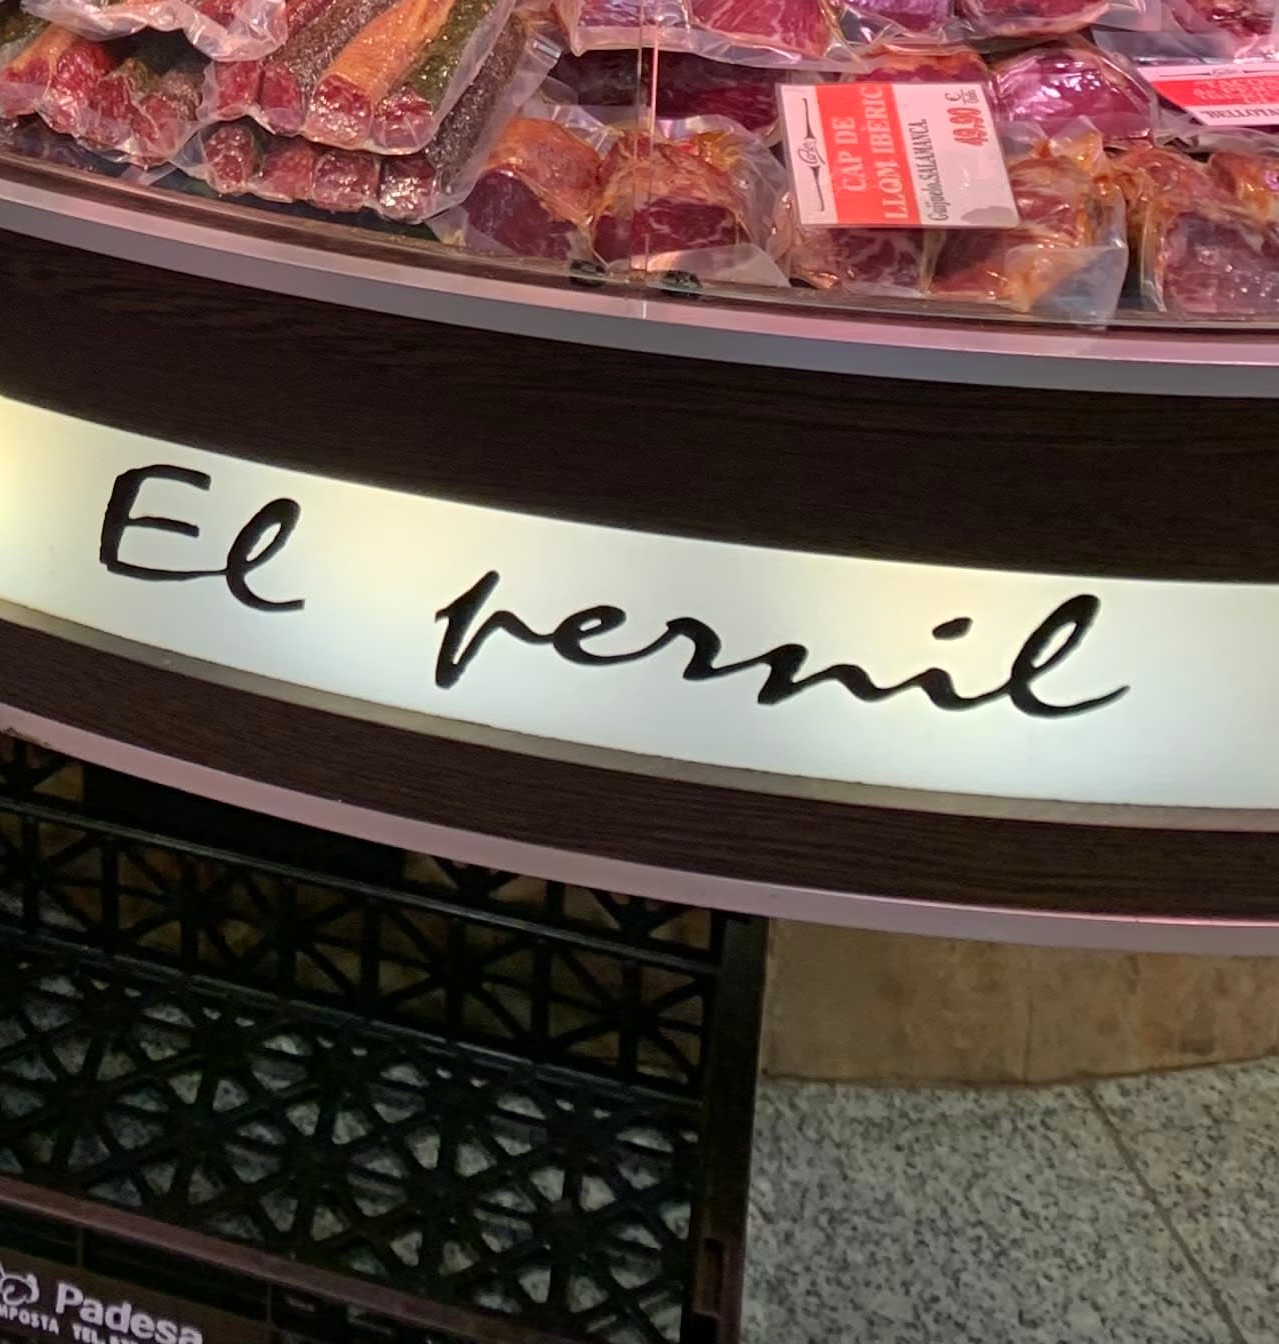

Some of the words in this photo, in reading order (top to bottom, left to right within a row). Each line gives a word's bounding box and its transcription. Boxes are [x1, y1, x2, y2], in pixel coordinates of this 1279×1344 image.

[833, 116, 859, 145] DE
[860, 85, 895, 154] IBÈRIC
[946, 107, 989, 146] 49.90
[838, 151, 866, 192] CAP
[871, 159, 910, 220] LLOM
[97, 463, 306, 614] El
[436, 569, 1132, 719] pernil
[55, 1282, 203, 1344] Padesa
